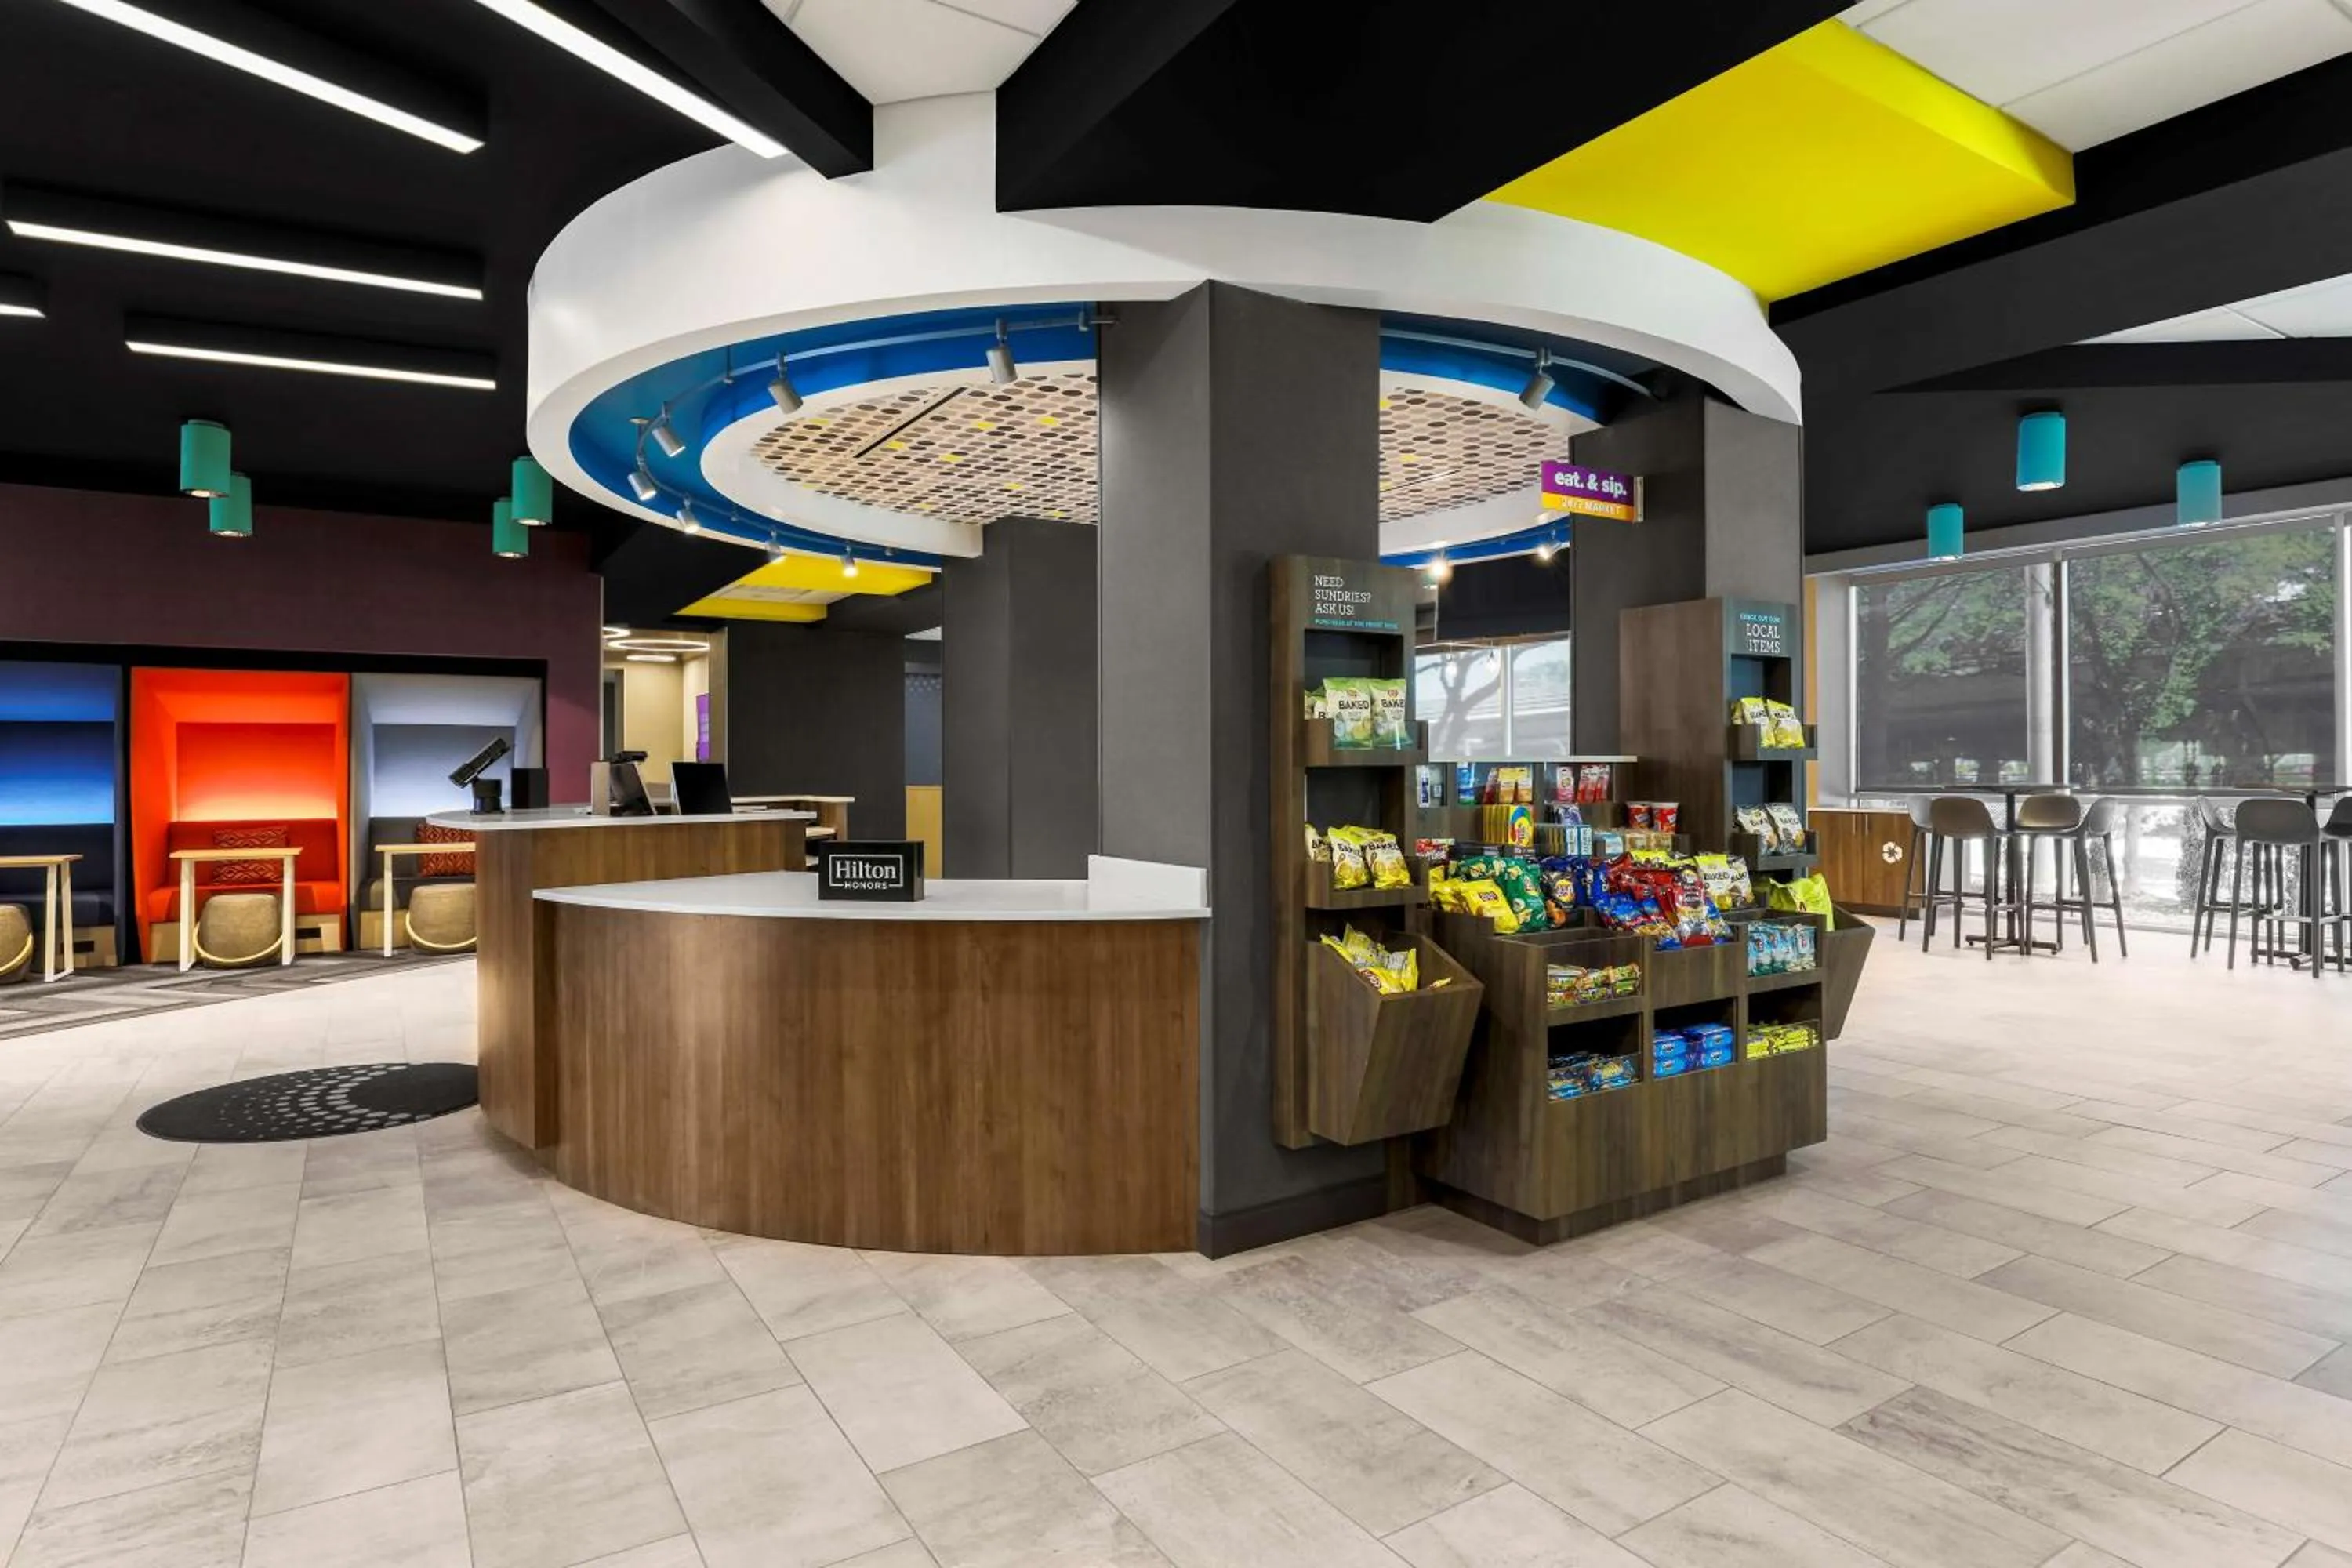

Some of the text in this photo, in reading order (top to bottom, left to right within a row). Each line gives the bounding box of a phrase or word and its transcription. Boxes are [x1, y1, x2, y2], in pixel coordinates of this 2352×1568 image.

[1555, 471, 1627, 499] eat. & sip.
[1314, 575, 1345, 587] NEED
[1315, 589, 1371, 603] SUNDRIES?
[1315, 603, 1337, 615] ASK
[1746, 622, 1780, 639] LOCAL
[1749, 639, 1780, 653] ITEMS
[1338, 700, 1369, 710] BAKED
[1381, 699, 1406, 708] BAKE
[835, 860, 897, 879] Hilton
[844, 881, 887, 890] HONORS
